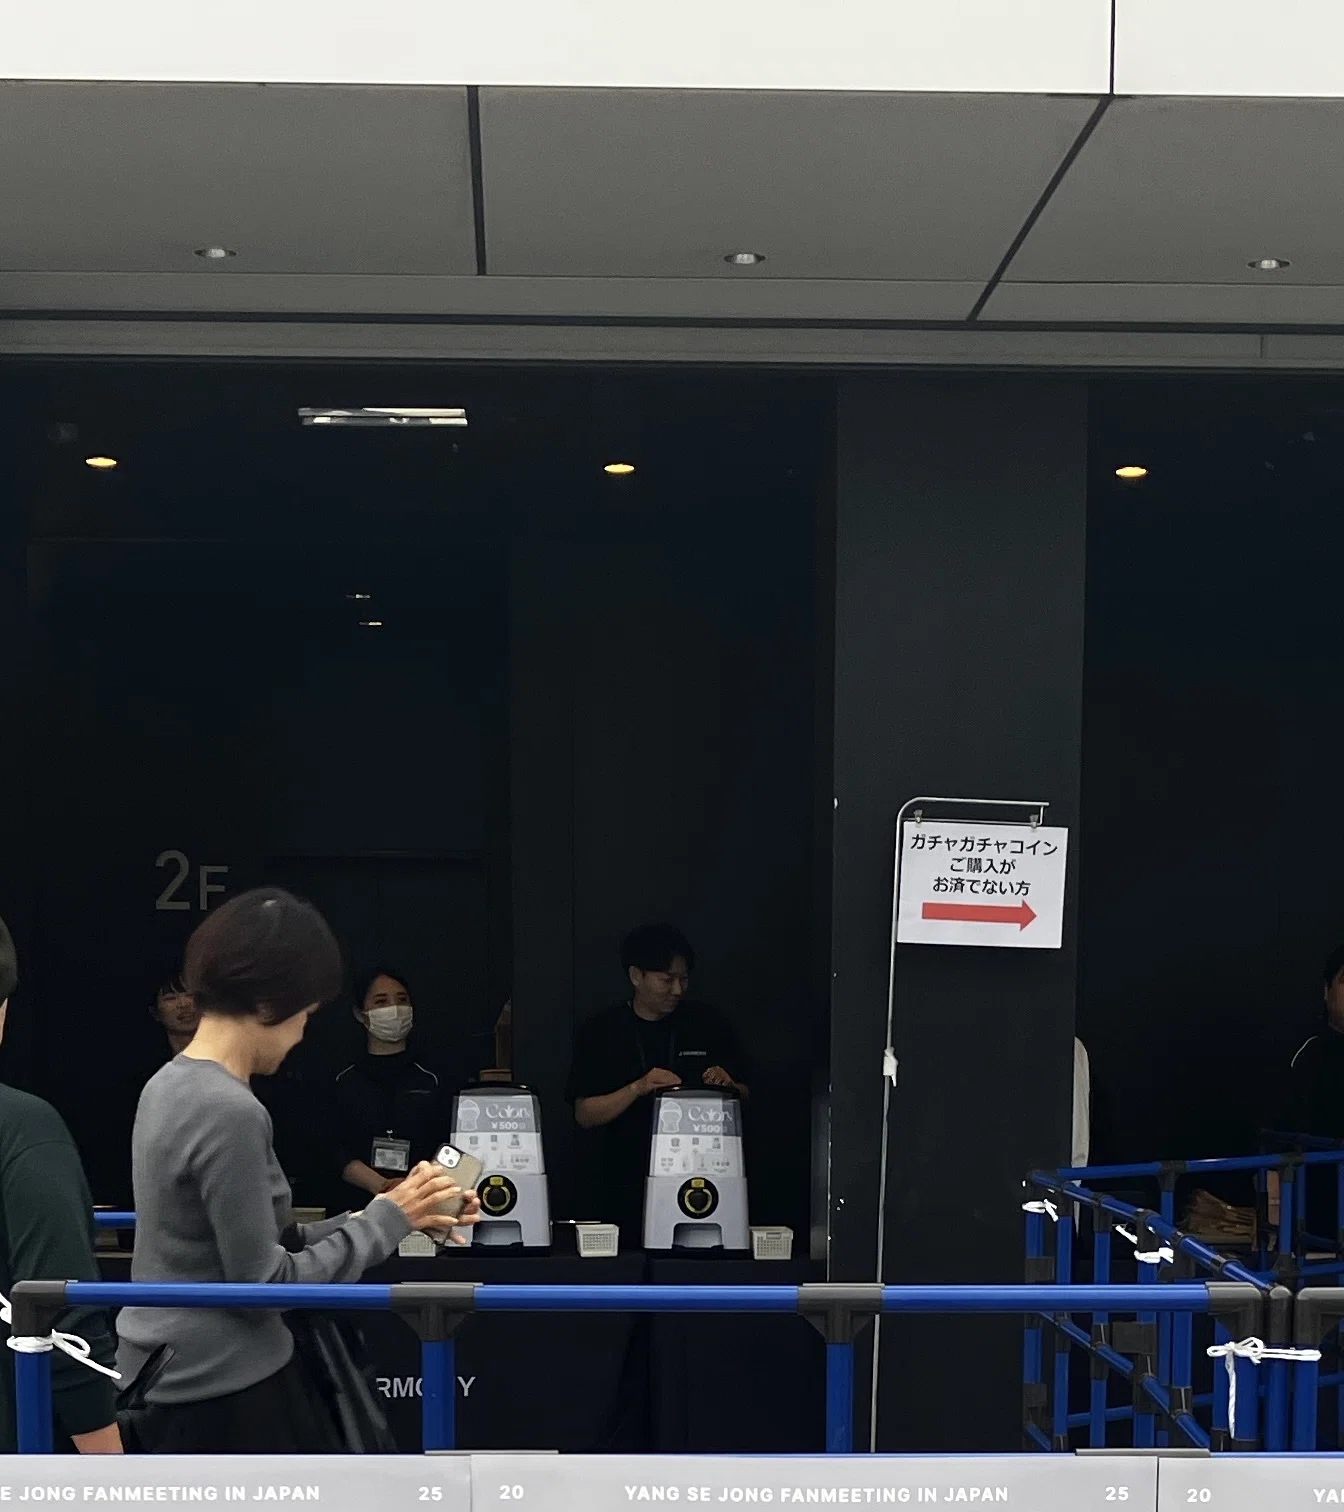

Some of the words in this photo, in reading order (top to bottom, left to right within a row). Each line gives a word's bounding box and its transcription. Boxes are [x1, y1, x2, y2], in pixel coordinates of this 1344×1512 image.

[910, 833, 1058, 856] ガチャガチャコイン
[950, 857, 1016, 875] ご購入が
[155, 849, 229, 911] 2F
[932, 876, 1031, 897] お済でない方
[20, 1487, 76, 1501] JONG
[83, 1487, 218, 1501] FANMEETING
[225, 1487, 246, 1501] IN
[253, 1486, 320, 1501] JAPAN
[419, 1486, 443, 1500] 25
[499, 1485, 524, 1499] 20
[624, 1486, 680, 1500] YANG
[688, 1487, 711, 1501] SE
[718, 1487, 774, 1502] JONG
[781, 1488, 910, 1503] FANMEETING
[918, 1488, 937, 1503] IN
[944, 1487, 1008, 1501] JAPAN
[1105, 1487, 1129, 1500] 25
[1187, 1488, 1211, 1502] 20
